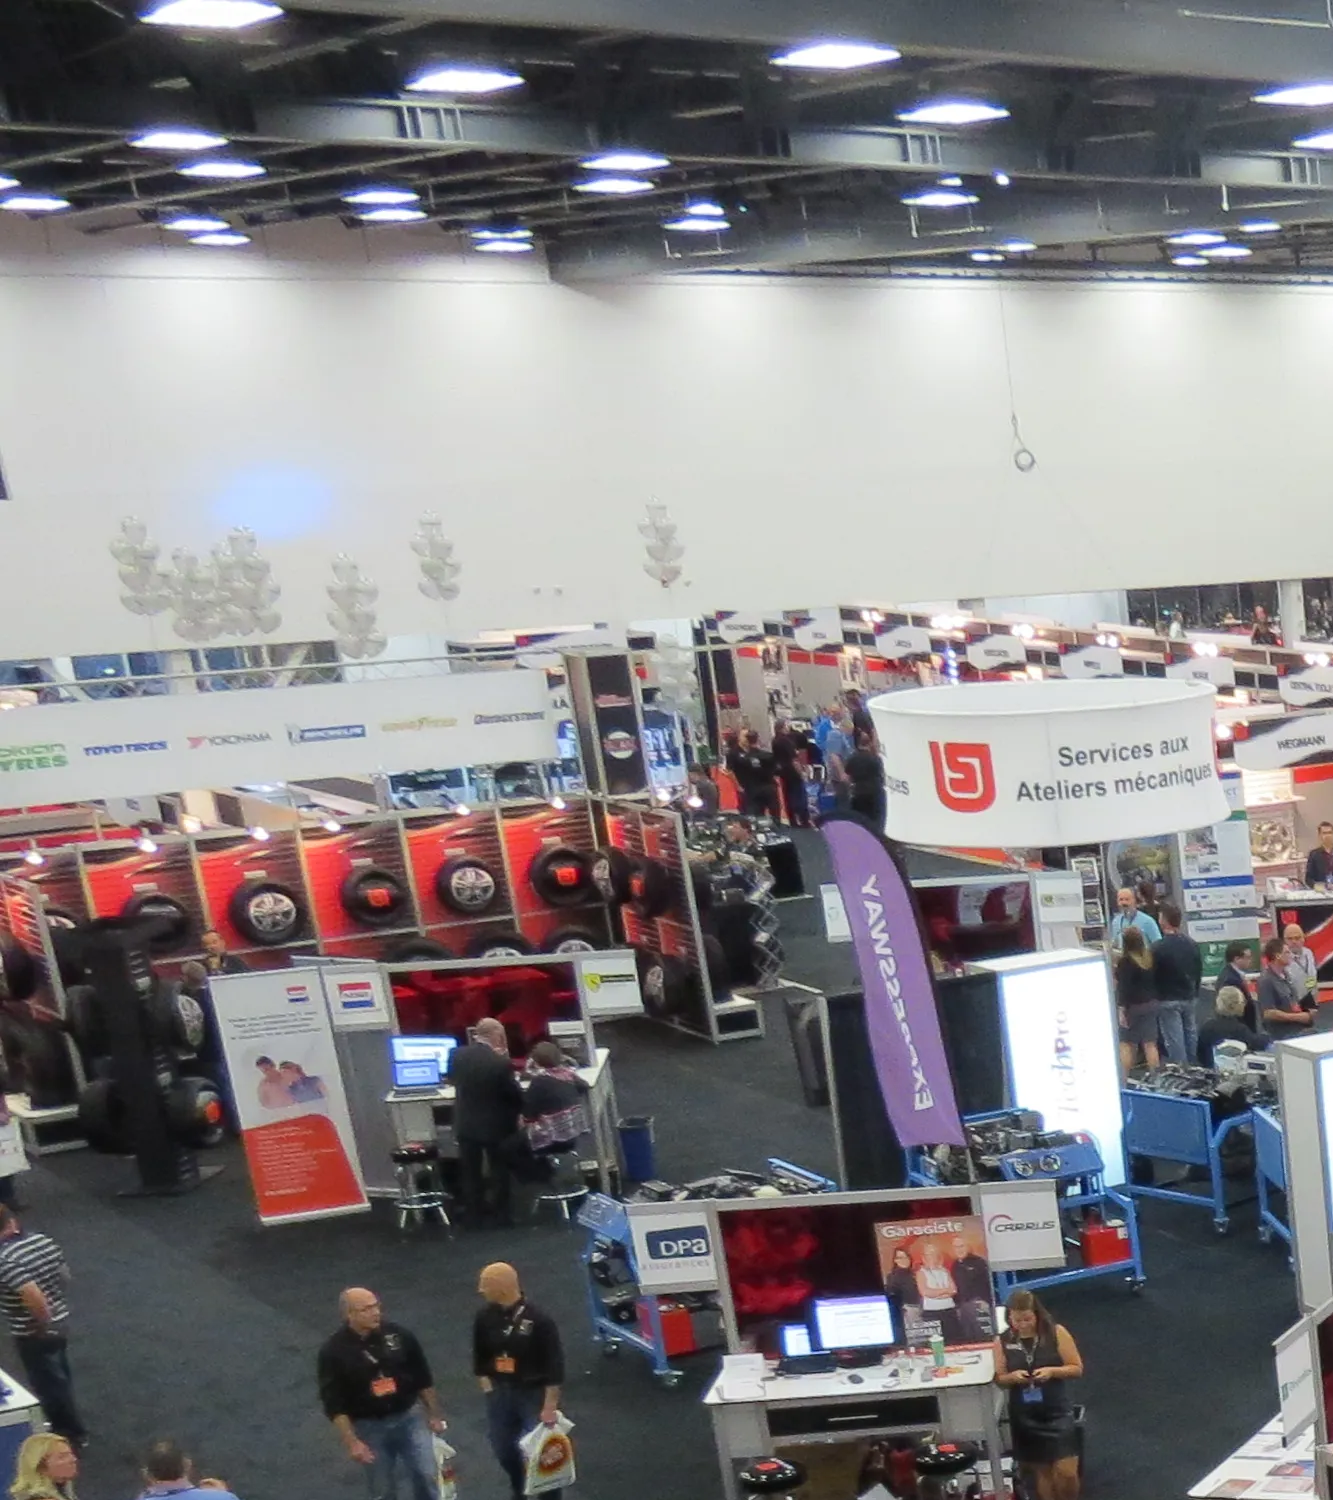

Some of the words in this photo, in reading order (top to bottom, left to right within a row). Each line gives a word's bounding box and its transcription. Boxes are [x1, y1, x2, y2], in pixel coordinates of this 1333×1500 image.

[1057, 743, 1155, 768] Services
[1159, 735, 1190, 756] aux
[1016, 774, 1108, 802] Ateliers
[1114, 762, 1214, 795] mécaniques
[640, 1257, 710, 1271] assurances
